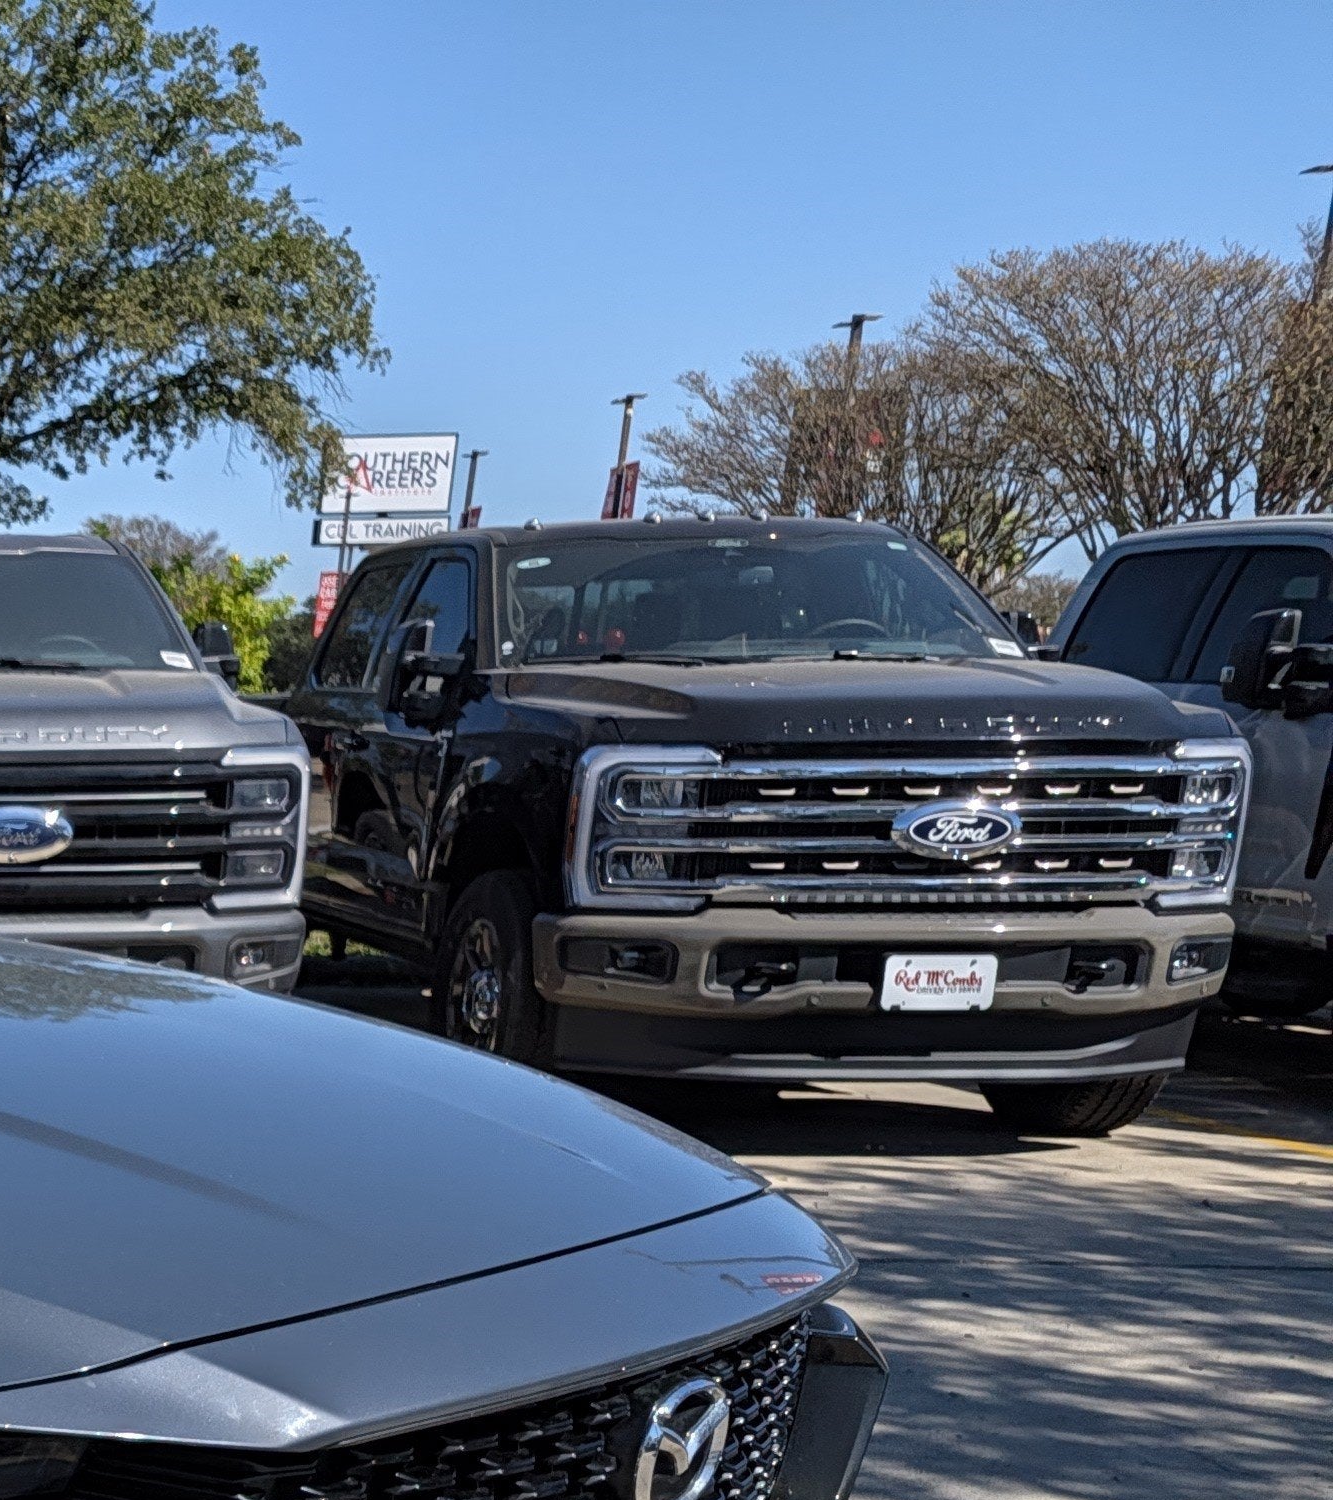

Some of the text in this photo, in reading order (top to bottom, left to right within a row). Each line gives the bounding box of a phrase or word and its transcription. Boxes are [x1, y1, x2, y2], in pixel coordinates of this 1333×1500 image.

[339, 450, 451, 474] OUTHERN
[363, 521, 444, 539] TRAINING
[927, 815, 992, 843] Ford
[894, 968, 983, 992] Red McCombs
